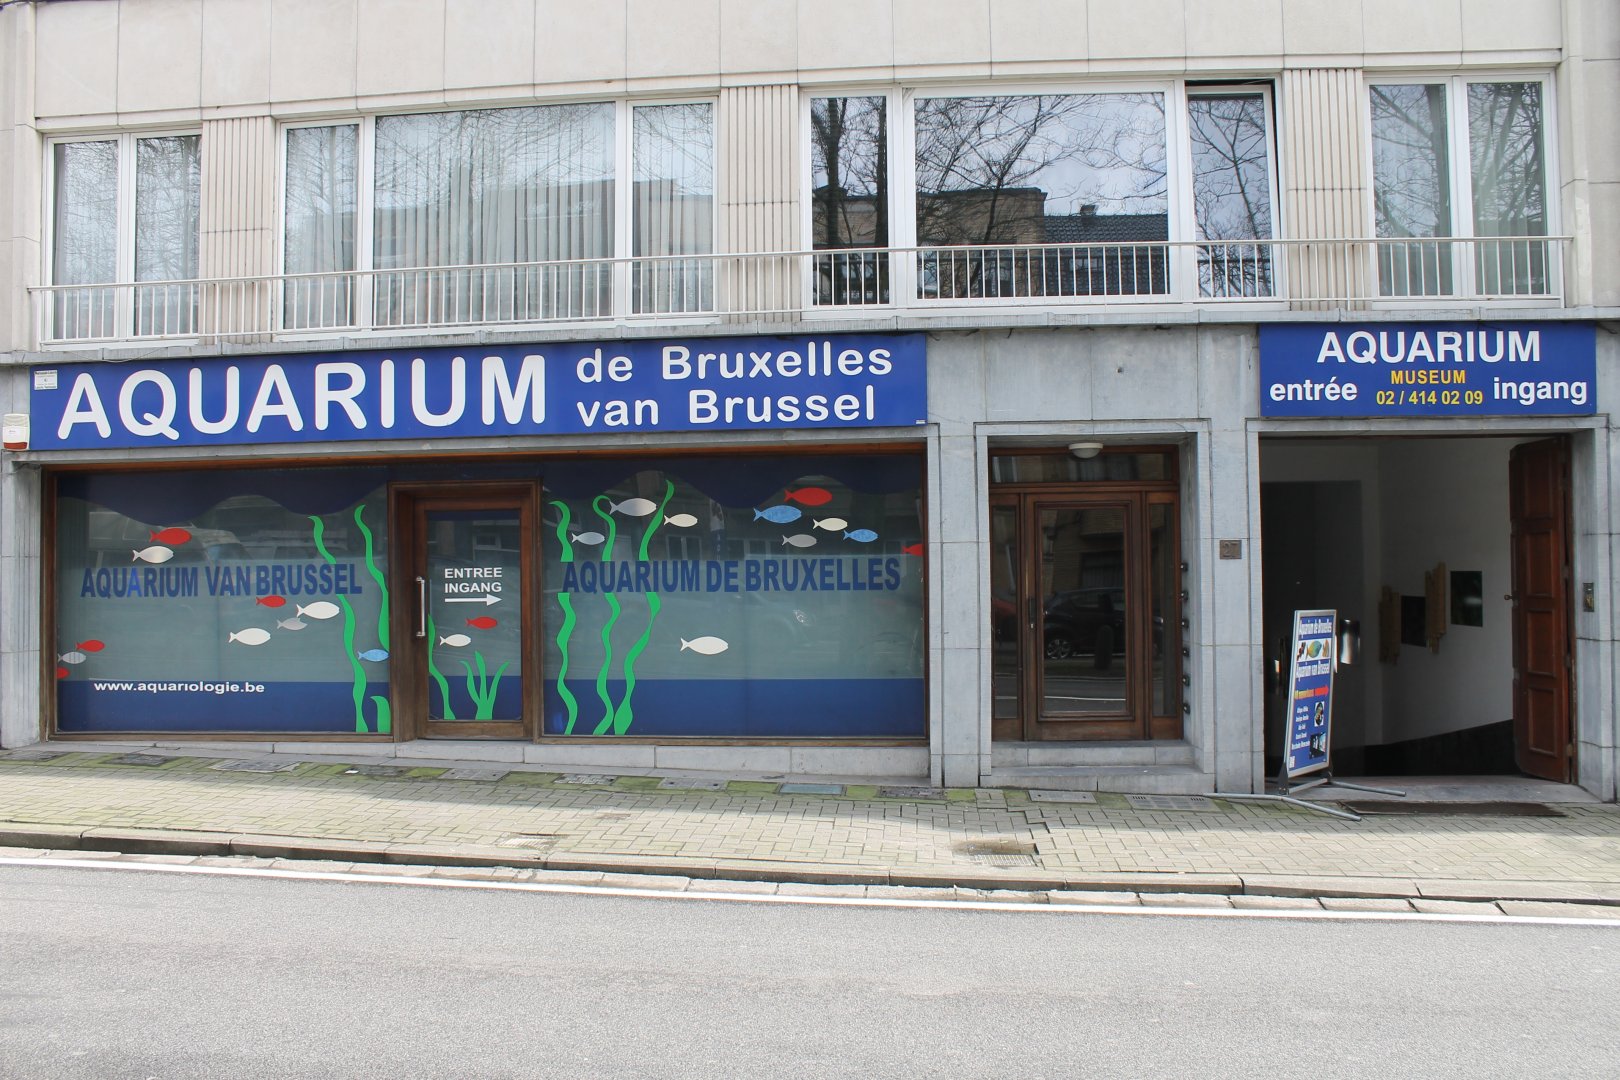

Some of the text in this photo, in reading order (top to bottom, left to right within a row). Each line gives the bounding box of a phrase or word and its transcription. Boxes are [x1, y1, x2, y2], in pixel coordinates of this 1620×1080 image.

[1316, 331, 1540, 364] AQUARIUM
[576, 341, 892, 383] de Bruxelles
[1269, 376, 1358, 402] entrée
[1390, 370, 1466, 385] MUSEUM
[1493, 377, 1587, 405] ingang
[58, 355, 546, 440] AQUARIUM
[576, 385, 874, 427] van Brussel
[1376, 391, 1395, 405] 02
[1408, 390, 1437, 405] 414
[1441, 390, 1460, 405] 02
[1464, 390, 1483, 405] 09
[80, 563, 363, 598] AQUARIUM VAN BRUSSEL
[444, 567, 503, 579] ENTREE
[562, 557, 901, 593] AQUARIUM DE BRUXELLES
[444, 581, 502, 594] INGANG
[94, 681, 265, 694] www.aquariologie.be
